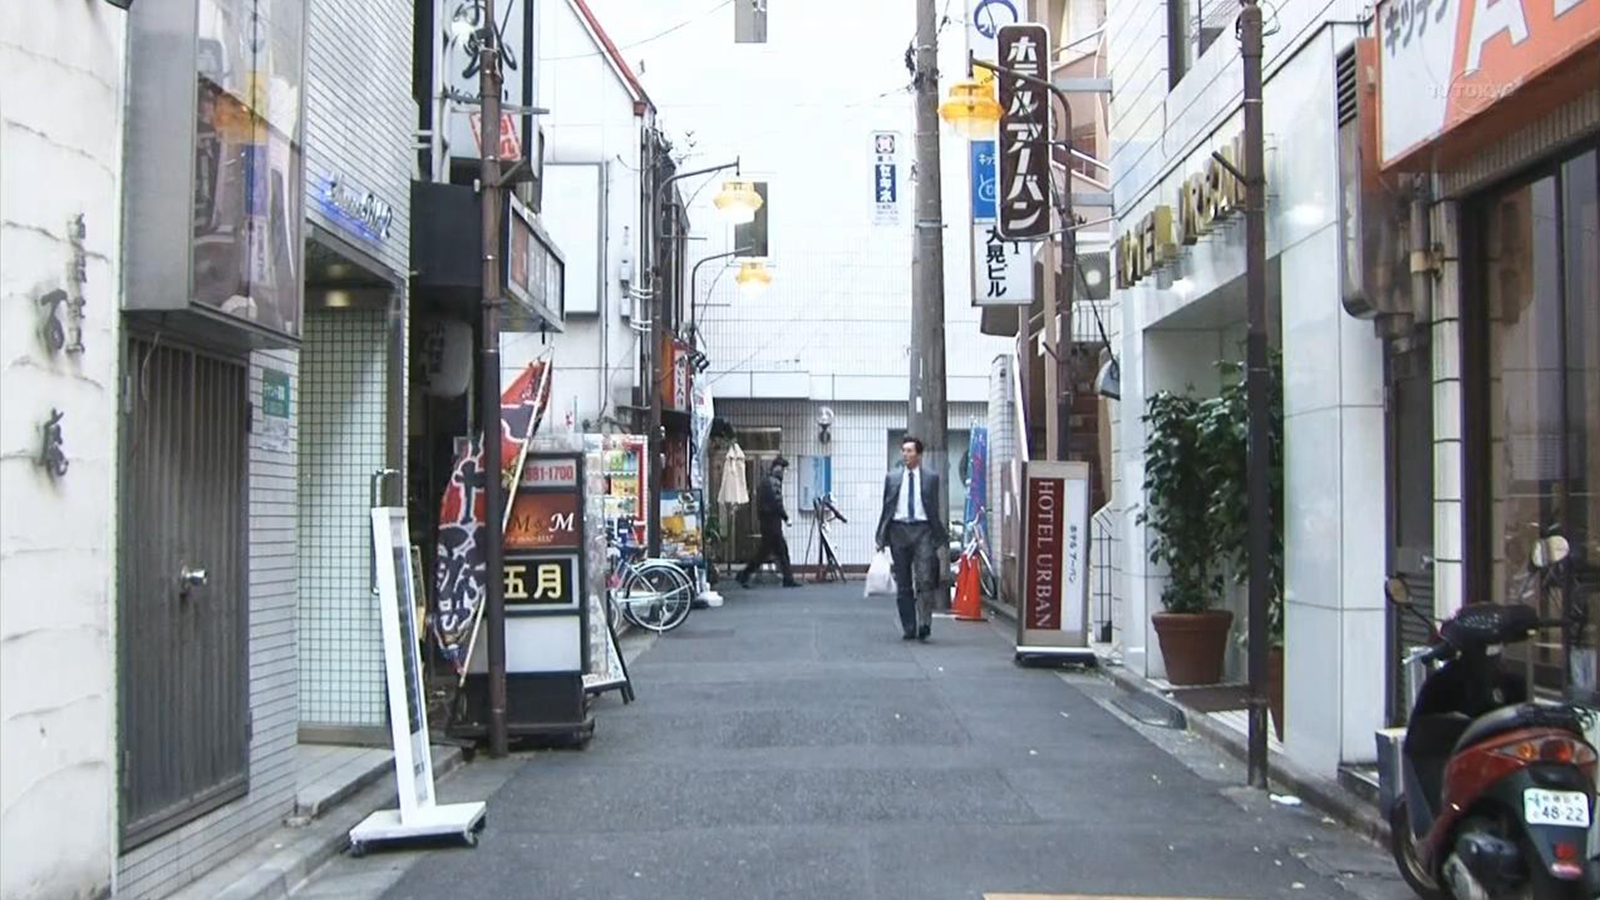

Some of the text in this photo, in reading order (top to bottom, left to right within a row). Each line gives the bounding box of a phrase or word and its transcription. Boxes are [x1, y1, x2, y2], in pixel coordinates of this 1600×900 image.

[1385, 0, 1450, 57] キッチ
[1007, 36, 1044, 230] ホテルアーバン
[986, 226, 1007, 298] 大晃ビル
[548, 512, 575, 532] M
[1036, 481, 1054, 627] HOTEL URBAN
[503, 563, 562, 599] 五月
